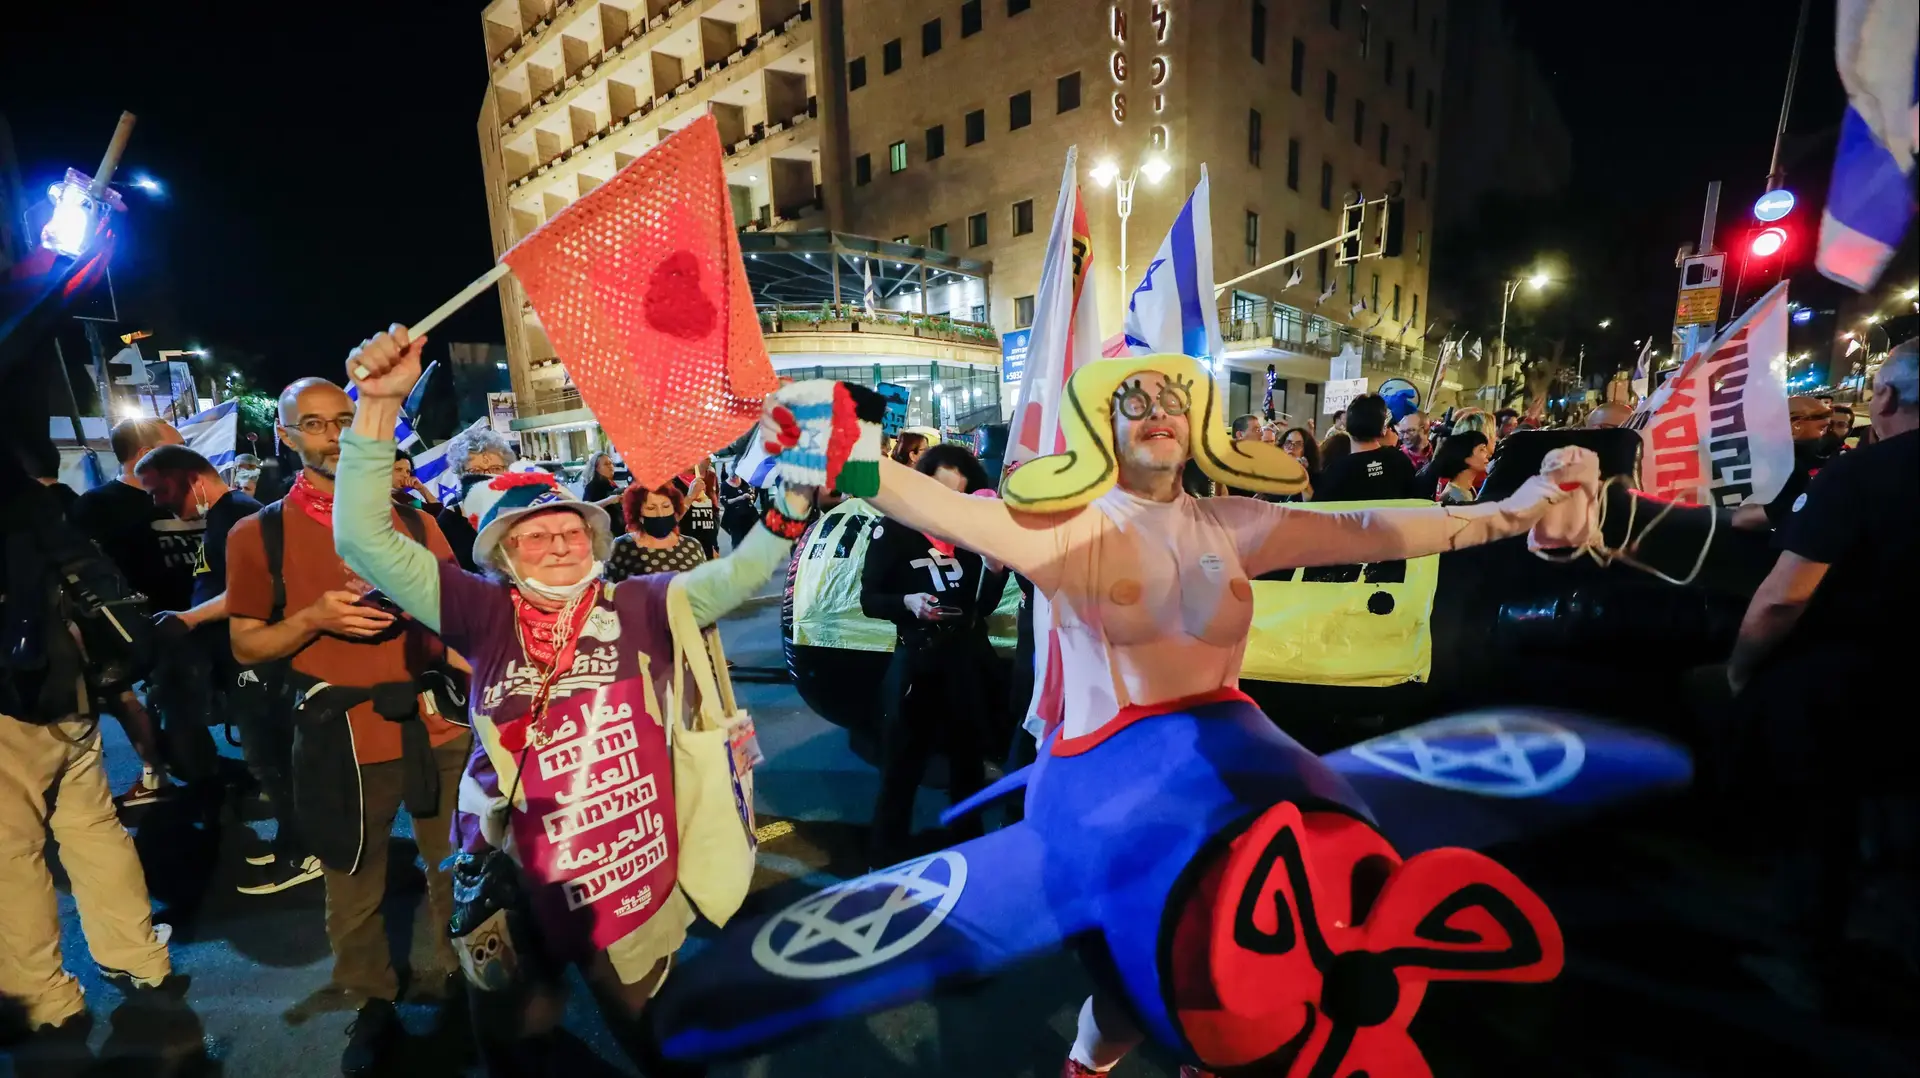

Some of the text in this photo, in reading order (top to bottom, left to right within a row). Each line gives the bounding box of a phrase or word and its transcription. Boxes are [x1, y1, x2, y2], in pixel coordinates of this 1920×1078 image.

[593, 728, 632, 756] יחד
[550, 782, 654, 837] האלימות
[570, 840, 665, 904] והפשיעה
